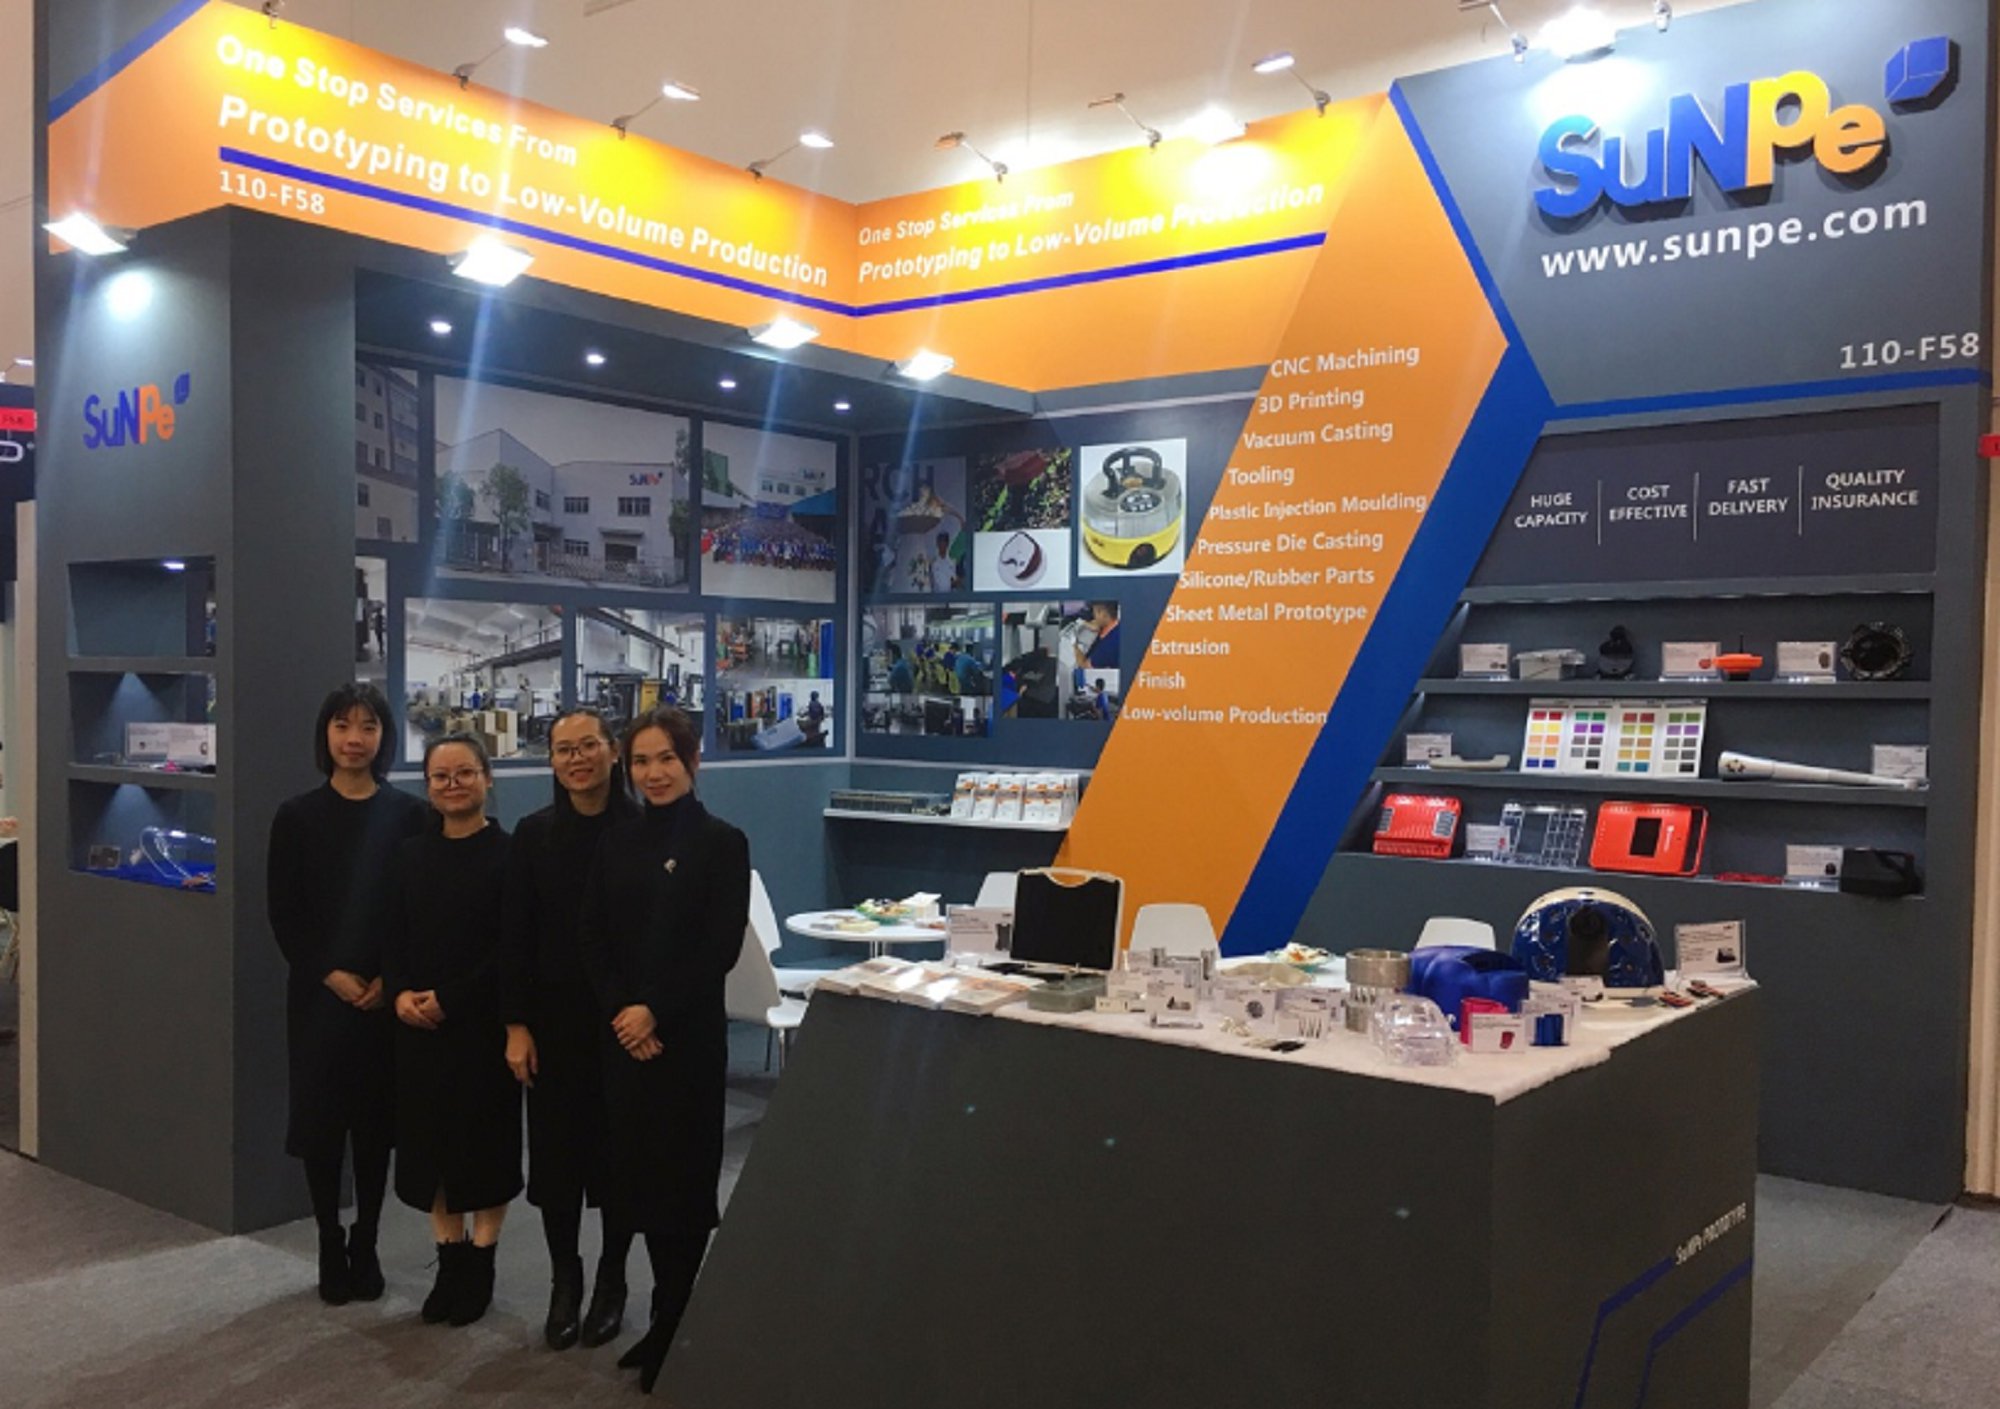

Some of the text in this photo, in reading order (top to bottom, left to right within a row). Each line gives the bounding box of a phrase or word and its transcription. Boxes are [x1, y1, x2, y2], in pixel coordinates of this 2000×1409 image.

[216, 34, 578, 166] One Stop Services From
[1534, 70, 1886, 217] SuNPe
[219, 94, 828, 287] Prototyping to Low-Volume Production
[219, 170, 325, 215] 110-F58
[858, 183, 1325, 283] Prototyping to Low-Volume Production
[859, 226, 891, 246] One
[896, 218, 935, 239] Stop
[940, 202, 1019, 230] Services
[1541, 199, 1928, 278] www.sunpe.com
[1271, 346, 1420, 378] CNC Machining
[1839, 332, 1980, 369] 110-F58
[1259, 387, 1364, 414] 3D Printing
[83, 384, 175, 449] SuNPe
[1243, 421, 1393, 449] Vacuum Casting
[1228, 465, 1295, 486] Tooling
[1727, 478, 1770, 494] FAST
[1825, 469, 1905, 488] QUALITY
[1531, 492, 1572, 508] HUGE
[1627, 484, 1670, 500] COST
[1811, 490, 1918, 511] INSURANCE
[1209, 492, 1427, 521] Plastic Injection Moulding
[1609, 504, 1688, 522] EFFECTIVE
[1709, 498, 1788, 516] DELIVERY
[1514, 510, 1589, 528] CAPACITY
[1197, 530, 1383, 555] Pressure Die Casting
[1180, 567, 1375, 589] Silicone/Rubber Parts
[1166, 603, 1368, 624] Sheet Metal Prototype
[1151, 639, 1230, 655] Extrusion
[1138, 671, 1185, 689] Finish
[1122, 705, 1328, 723] Low-volume Production
